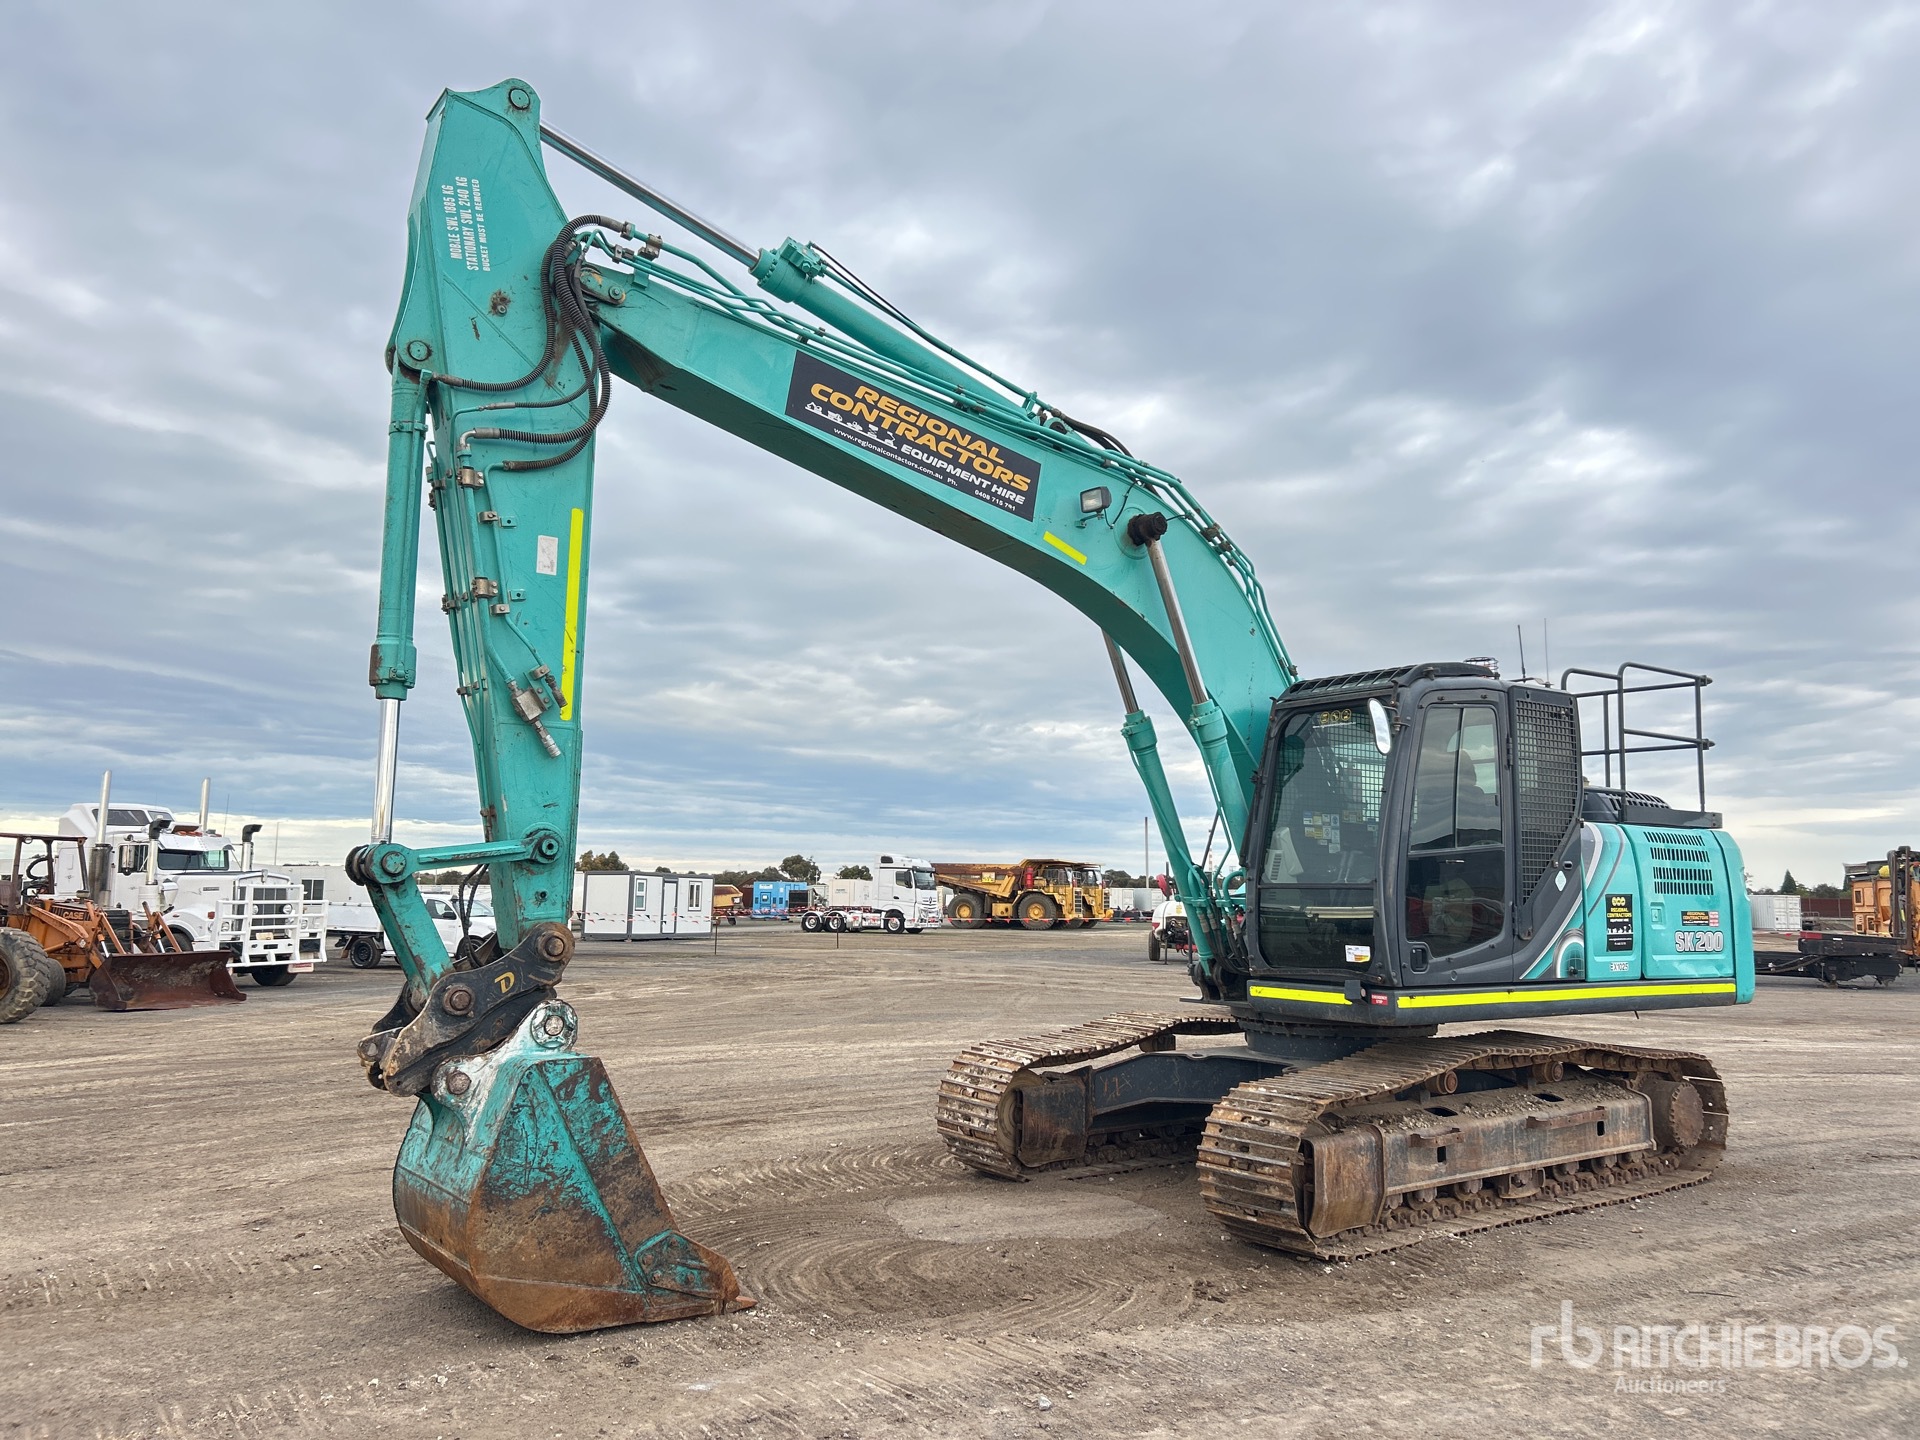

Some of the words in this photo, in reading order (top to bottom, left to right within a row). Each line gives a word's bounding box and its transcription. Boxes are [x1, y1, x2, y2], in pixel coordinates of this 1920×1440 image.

[441, 184, 454, 195] KG
[455, 176, 468, 187] KG
[457, 189, 471, 207] 2140
[471, 179, 483, 211] REMOVED
[443, 197, 457, 214] 1885
[446, 216, 459, 231] SWL
[460, 209, 473, 225] SWL
[475, 213, 484, 222] BE
[477, 224, 487, 243] MUST
[448, 233, 462, 259] MOBILE
[462, 226, 479, 271] STATIONARY
[480, 245, 491, 272] BUCKET
[855, 385, 1004, 464] REGIONAL
[811, 383, 1031, 492] CONTRACTORS
[901, 444, 991, 489] EQUIPMENT
[991, 484, 1026, 505] HIRE
[947, 477, 958, 487] Ph.
[63, 911, 85, 920] CASE
